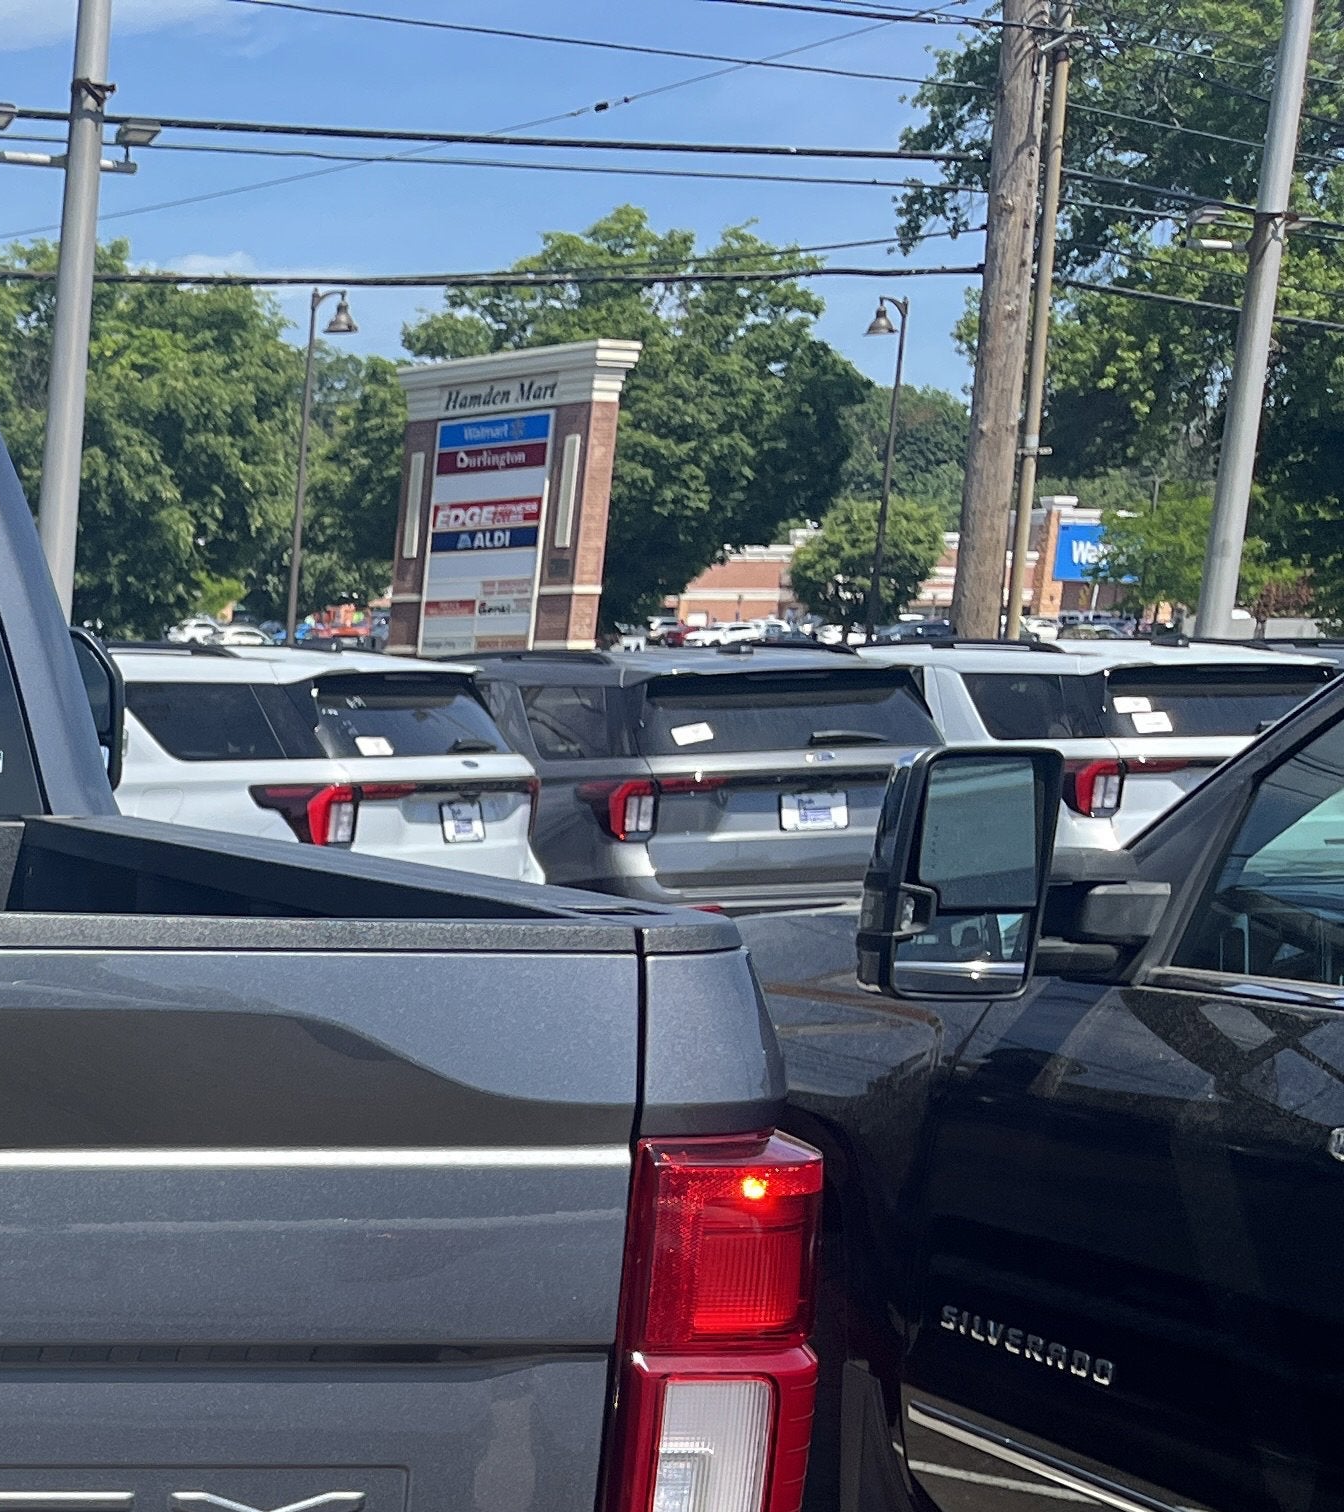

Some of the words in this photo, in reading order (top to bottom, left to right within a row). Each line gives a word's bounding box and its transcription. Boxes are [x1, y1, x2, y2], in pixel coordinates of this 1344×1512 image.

[444, 385, 511, 411] Hamden
[515, 380, 558, 403] Mart
[464, 421, 509, 440] Walmart
[436, 505, 495, 528] EDGE
[473, 529, 511, 549] ALDI
[940, 1304, 1116, 1386] SILVERADO
